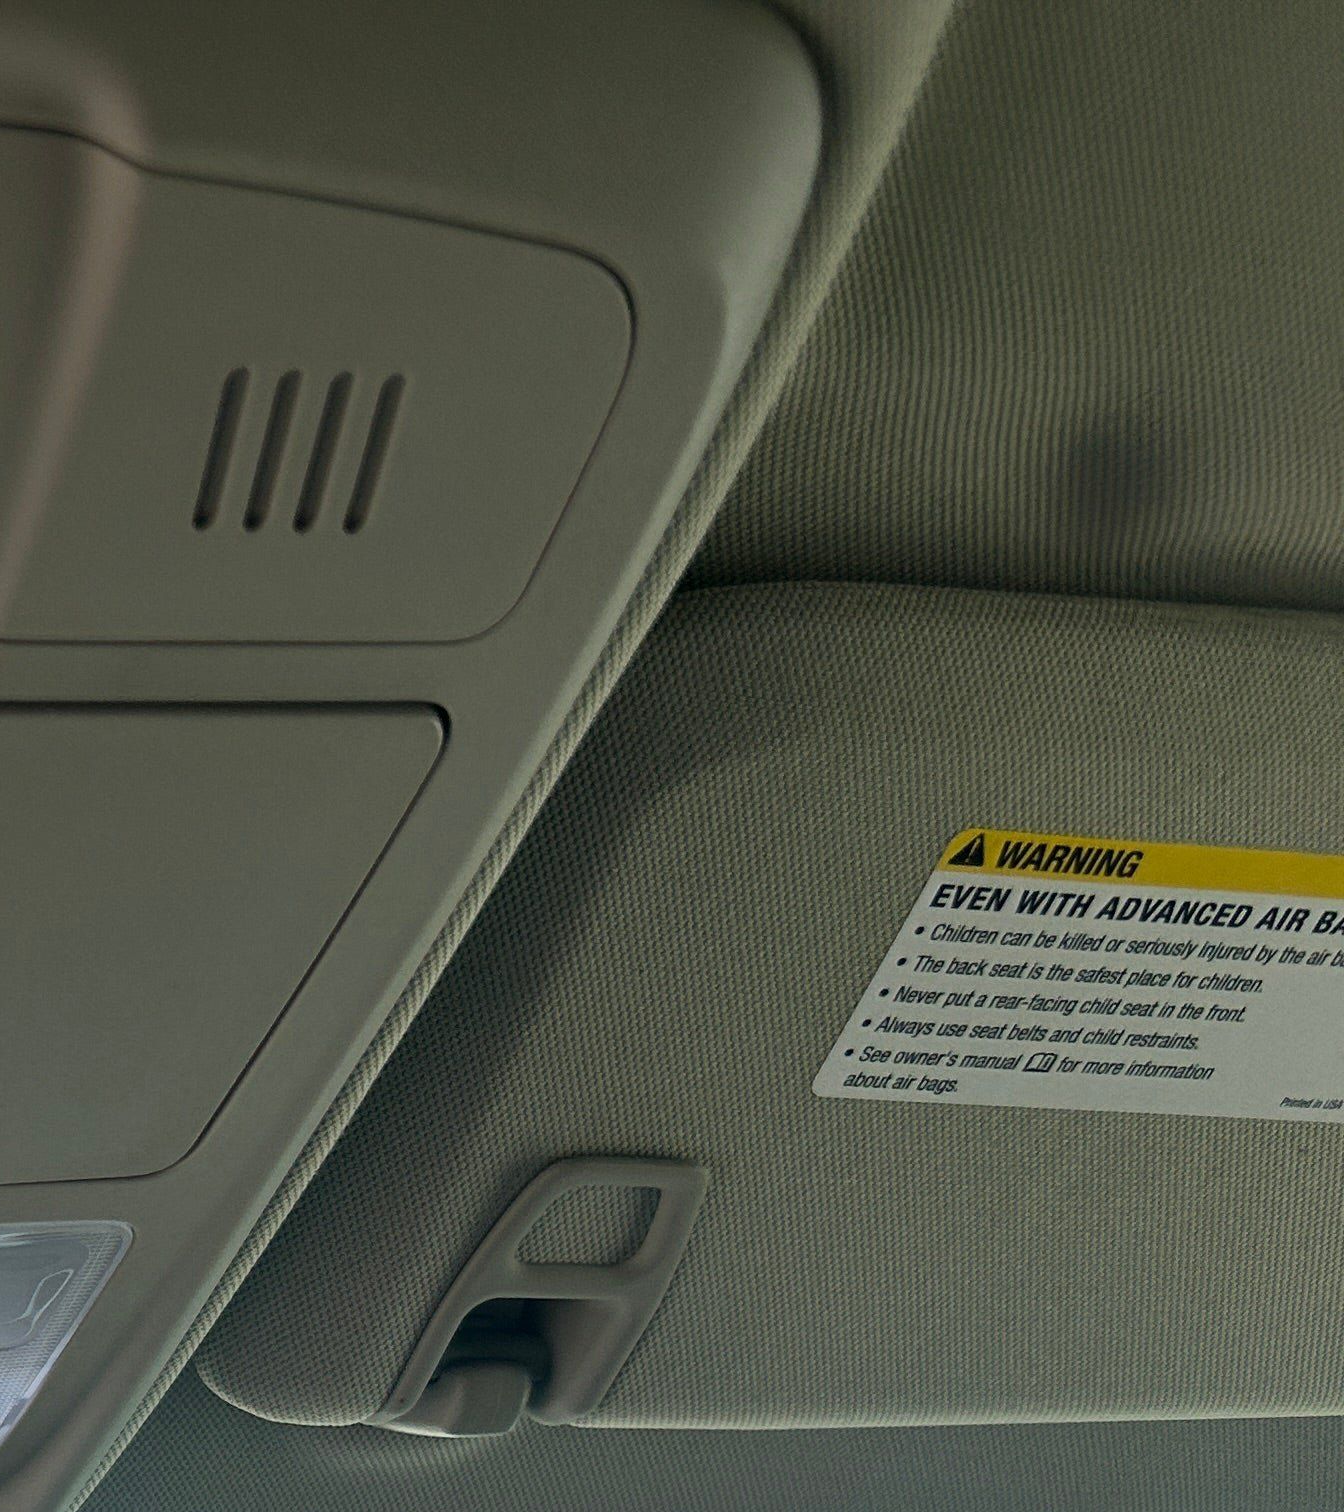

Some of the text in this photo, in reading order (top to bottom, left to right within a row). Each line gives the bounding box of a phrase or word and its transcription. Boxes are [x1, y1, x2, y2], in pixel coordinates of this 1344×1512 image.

[995, 840, 1143, 878] WARNING
[929, 884, 1012, 912] EVEN
[1015, 889, 1095, 918] WITH
[1095, 895, 1253, 928] ADVANCED
[1254, 906, 1310, 932] AIR
[930, 924, 1004, 944] Children
[1000, 931, 1033, 949] can
[1032, 930, 1057, 949] be
[1057, 932, 1106, 951] killed
[1105, 937, 1124, 952] or
[1125, 937, 1198, 960] seriously
[1198, 943, 1257, 962] injured
[1255, 946, 1278, 965] by
[1278, 946, 1306, 964] the
[1306, 949, 1331, 966] air
[913, 955, 1263, 993] The back seat is the safest place for children.
[893, 986, 1246, 1023] Never put a rear-facing child seat in the front.
[874, 1016, 1199, 1050] Always use seat belts and child restraints.
[858, 1046, 1215, 1081] See owner's manual for more information
[843, 1072, 958, 1095] about air bags.
